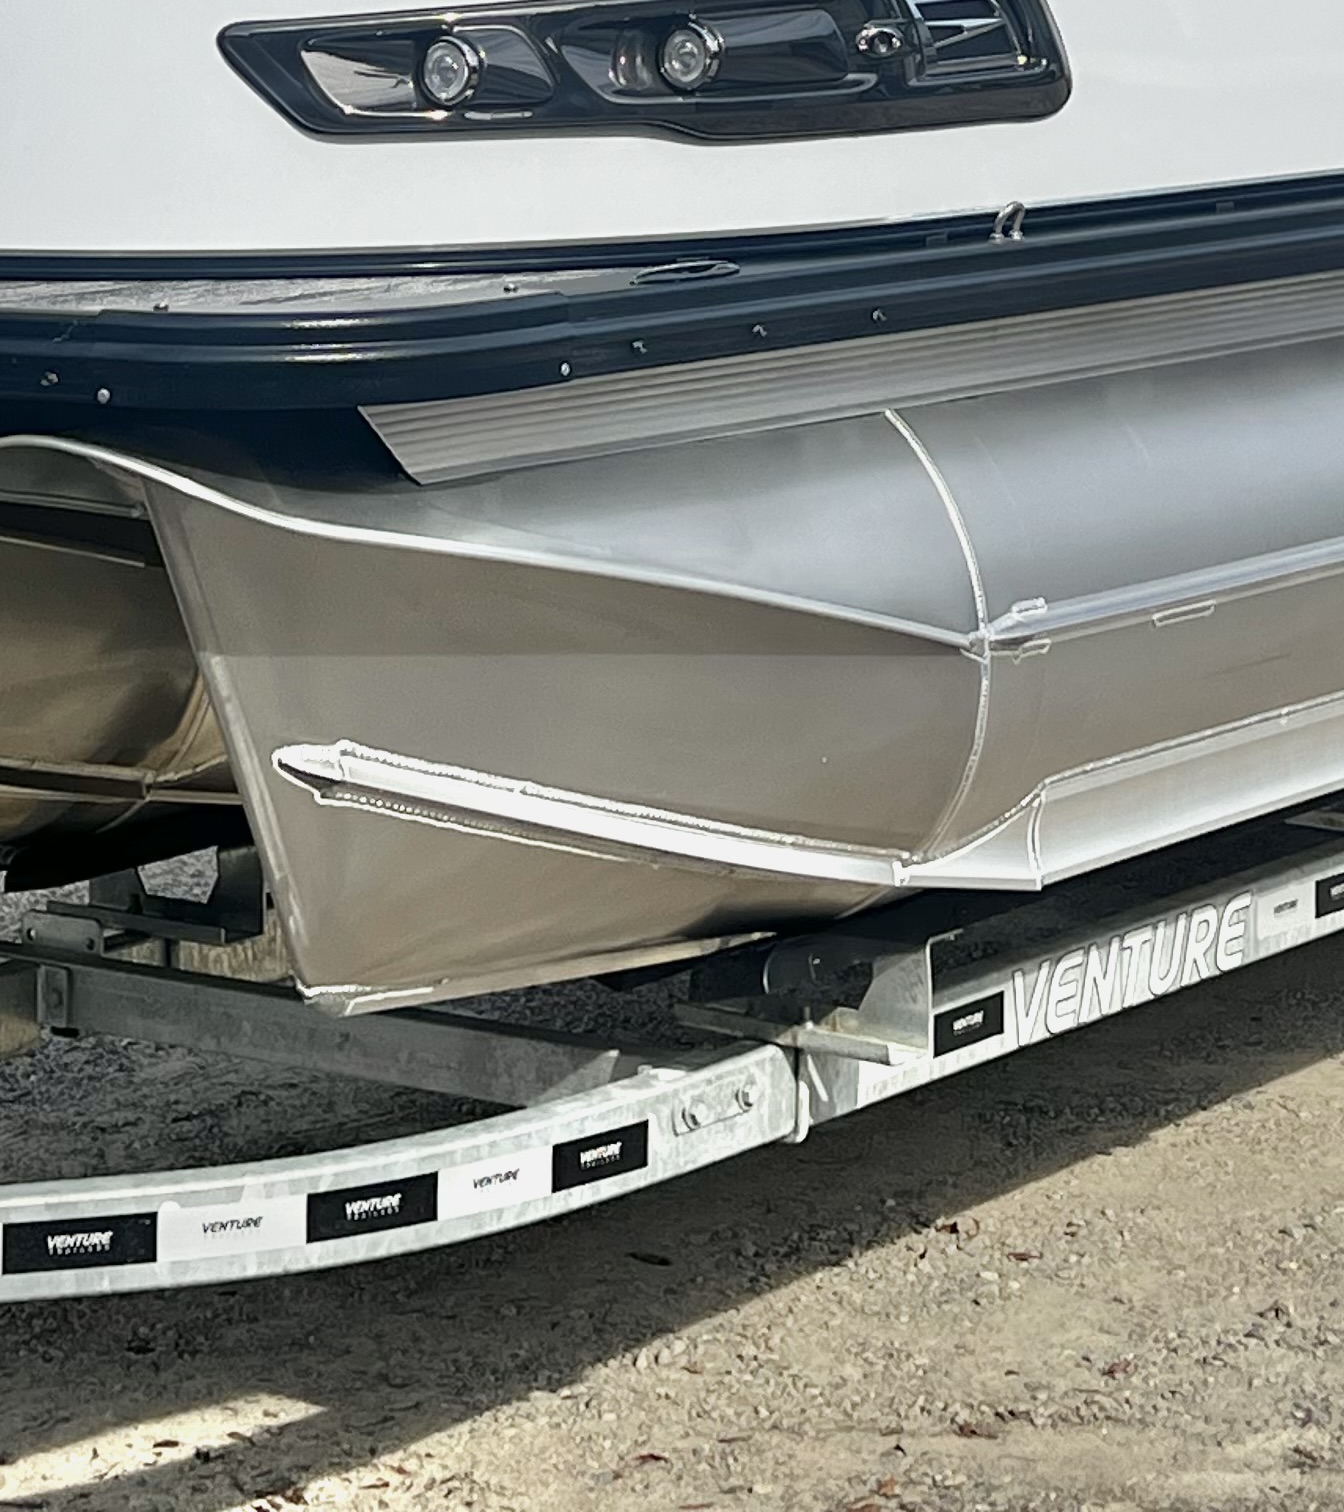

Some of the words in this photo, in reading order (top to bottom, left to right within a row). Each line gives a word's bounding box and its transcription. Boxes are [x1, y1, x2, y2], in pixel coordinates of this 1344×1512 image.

[1012, 890, 1254, 1048] VENTURE
[472, 1167, 520, 1189] VENTURE
[345, 1192, 402, 1215] VENTURE
[201, 1216, 264, 1234] VENTURE
[46, 1230, 114, 1249] VENTURE
